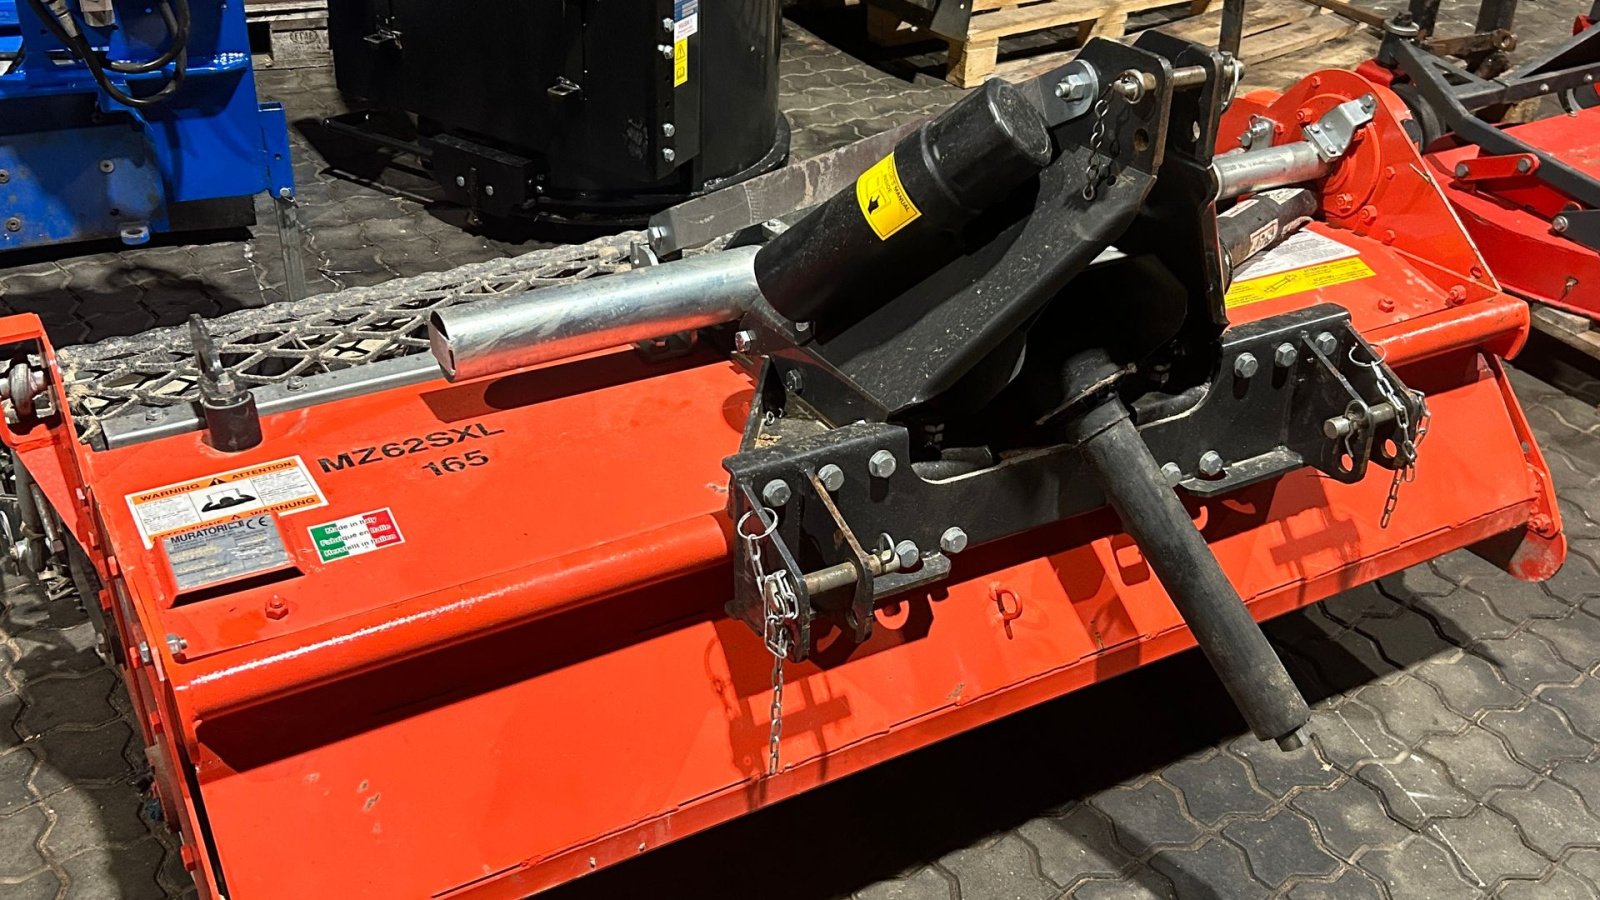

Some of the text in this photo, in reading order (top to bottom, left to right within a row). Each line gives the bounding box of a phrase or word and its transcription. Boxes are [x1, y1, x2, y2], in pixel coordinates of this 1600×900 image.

[894, 185, 910, 212] MANUAL
[317, 423, 505, 473] MZ62SXL
[232, 462, 292, 479] ATTENTION
[421, 450, 489, 476] 165
[140, 484, 200, 501] WARNING
[170, 524, 228, 543] MURATORI
[325, 524, 348, 533] Made
[359, 517, 376, 525] Italy
[321, 532, 358, 545] Fabrique
